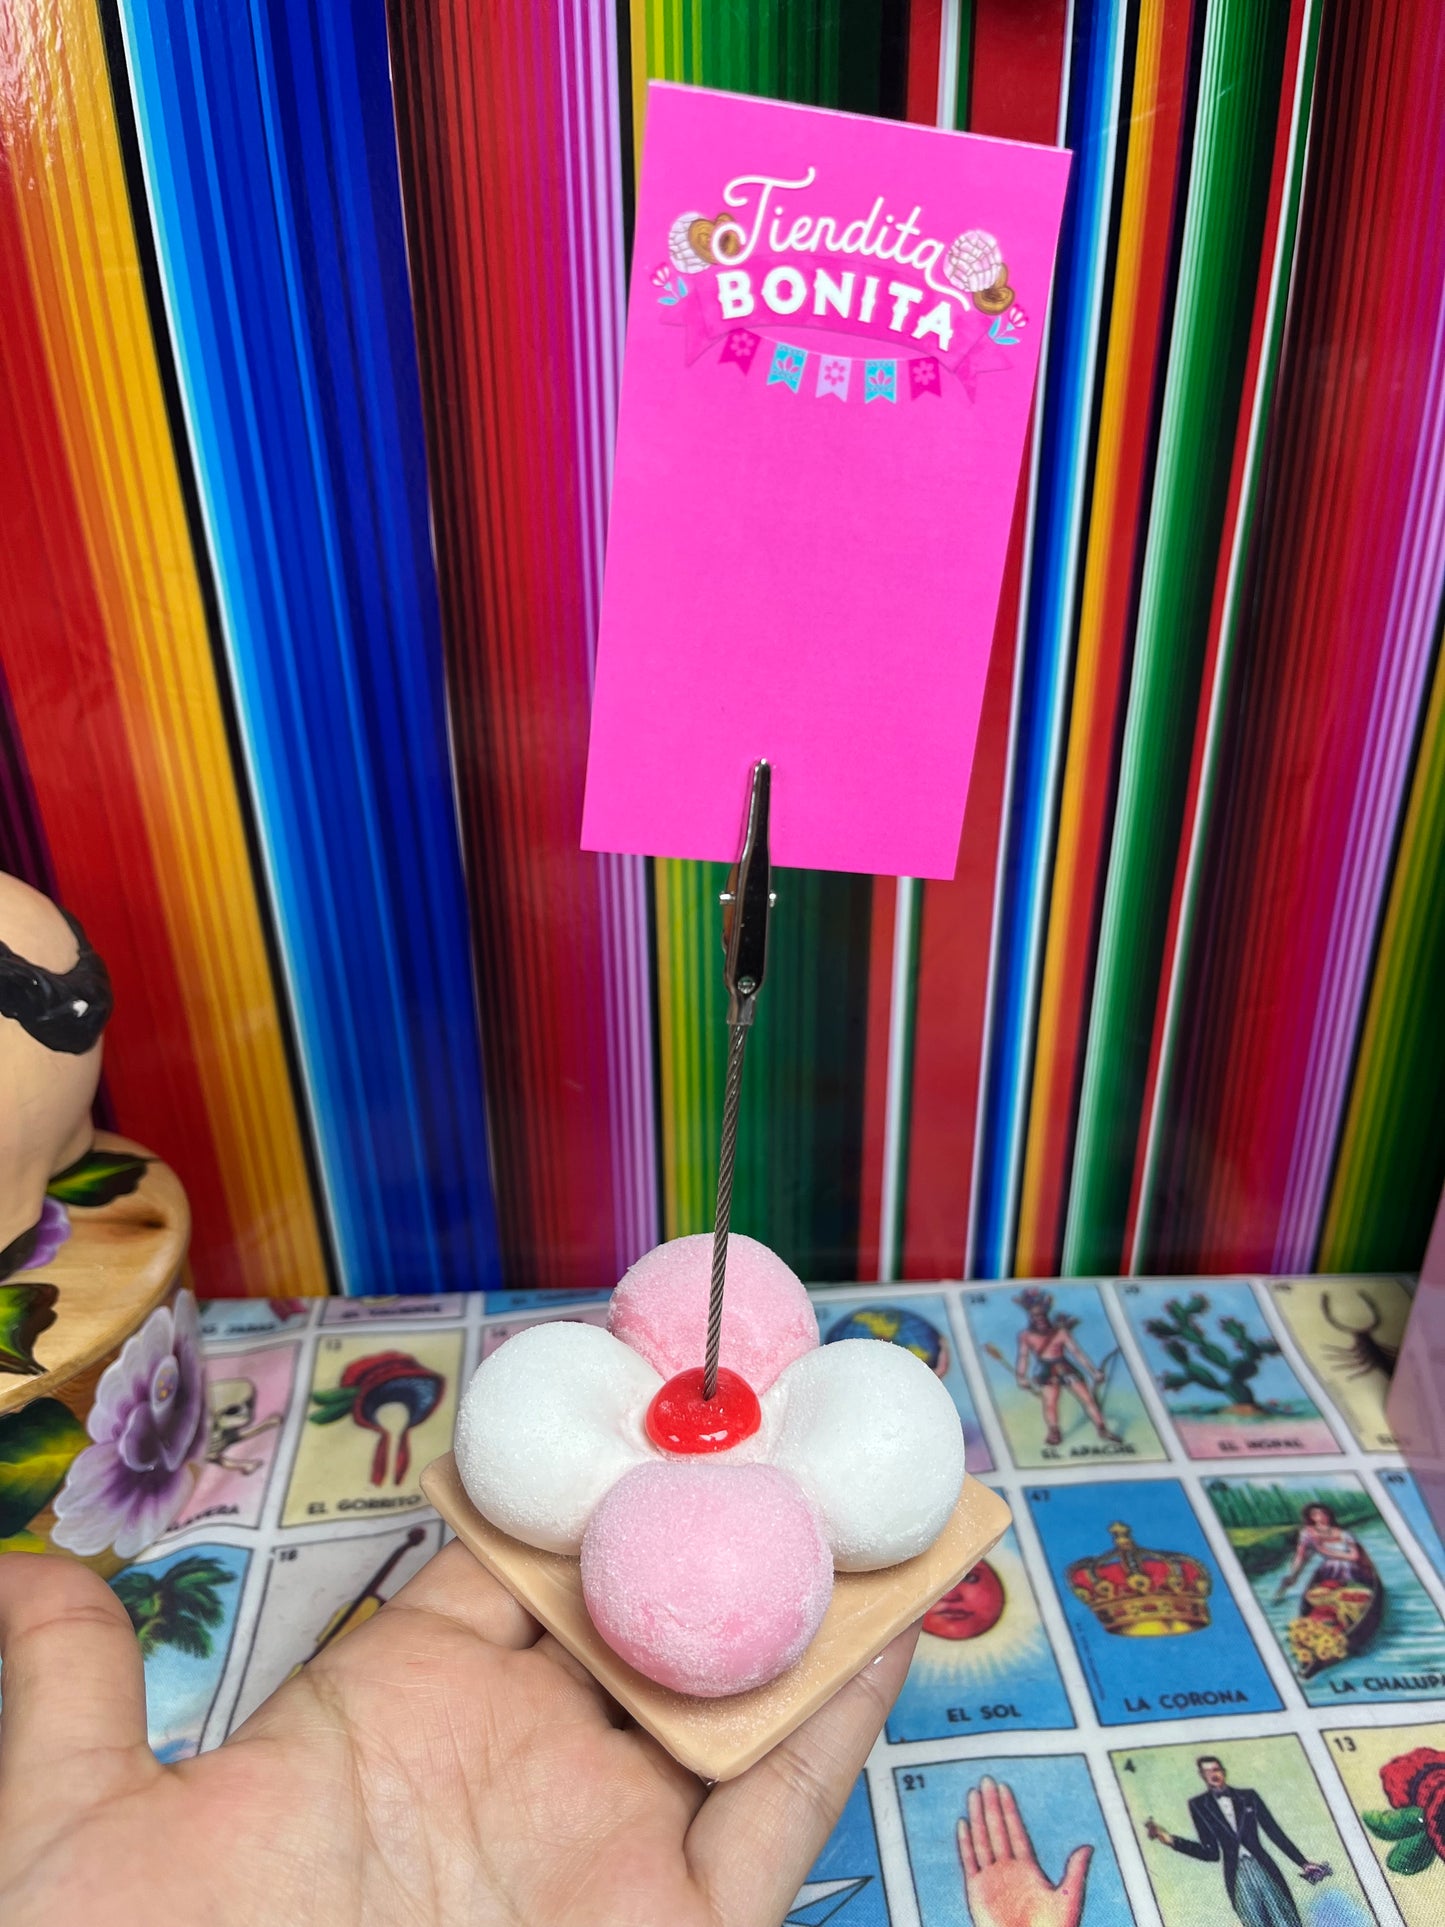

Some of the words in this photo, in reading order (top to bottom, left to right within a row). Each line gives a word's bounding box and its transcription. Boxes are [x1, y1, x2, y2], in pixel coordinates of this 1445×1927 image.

[711, 166, 971, 312] Tiendita
[716, 265, 955, 352] BONITA
[1328, 1680, 1355, 1694] LA
[1363, 1675, 1445, 1692] CHALUP
[1124, 1698, 1151, 1712] LA
[1159, 1689, 1249, 1710] CORONA
[946, 1708, 971, 1723] EL
[980, 1704, 1021, 1720] SOL
[1334, 1736, 1356, 1752] 13
[1124, 1758, 1136, 1773] 4
[902, 1774, 924, 1790] 21
